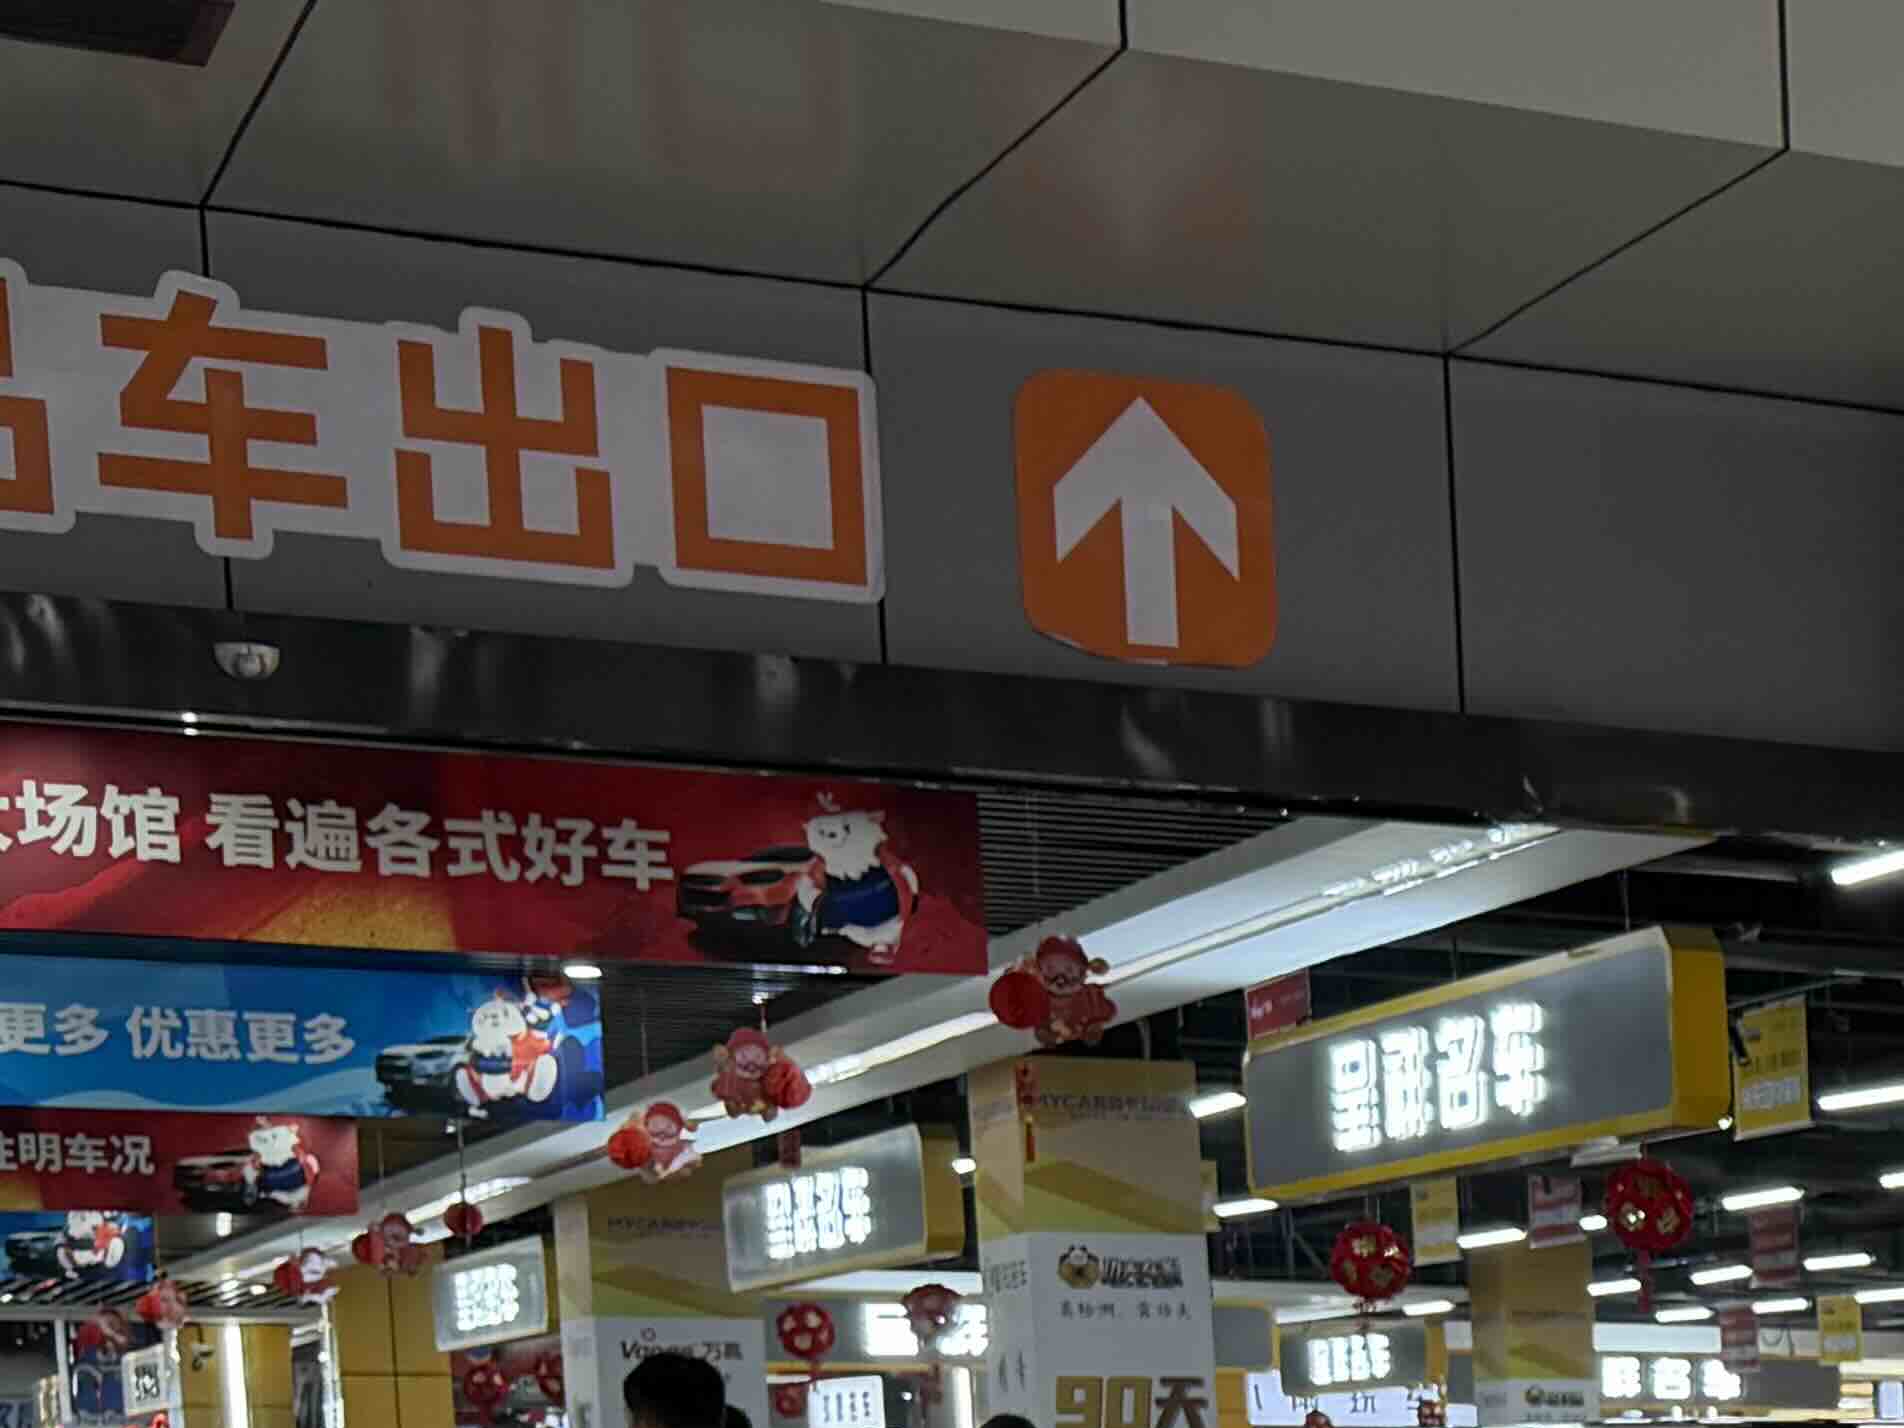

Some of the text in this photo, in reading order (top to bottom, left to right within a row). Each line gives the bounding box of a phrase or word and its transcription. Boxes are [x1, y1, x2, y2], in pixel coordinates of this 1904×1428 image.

[0, 277, 868, 586] 车出口
[0, 780, 675, 891] 场馆 看遍各式好车
[0, 1004, 356, 1065] 更多 优惠更多
